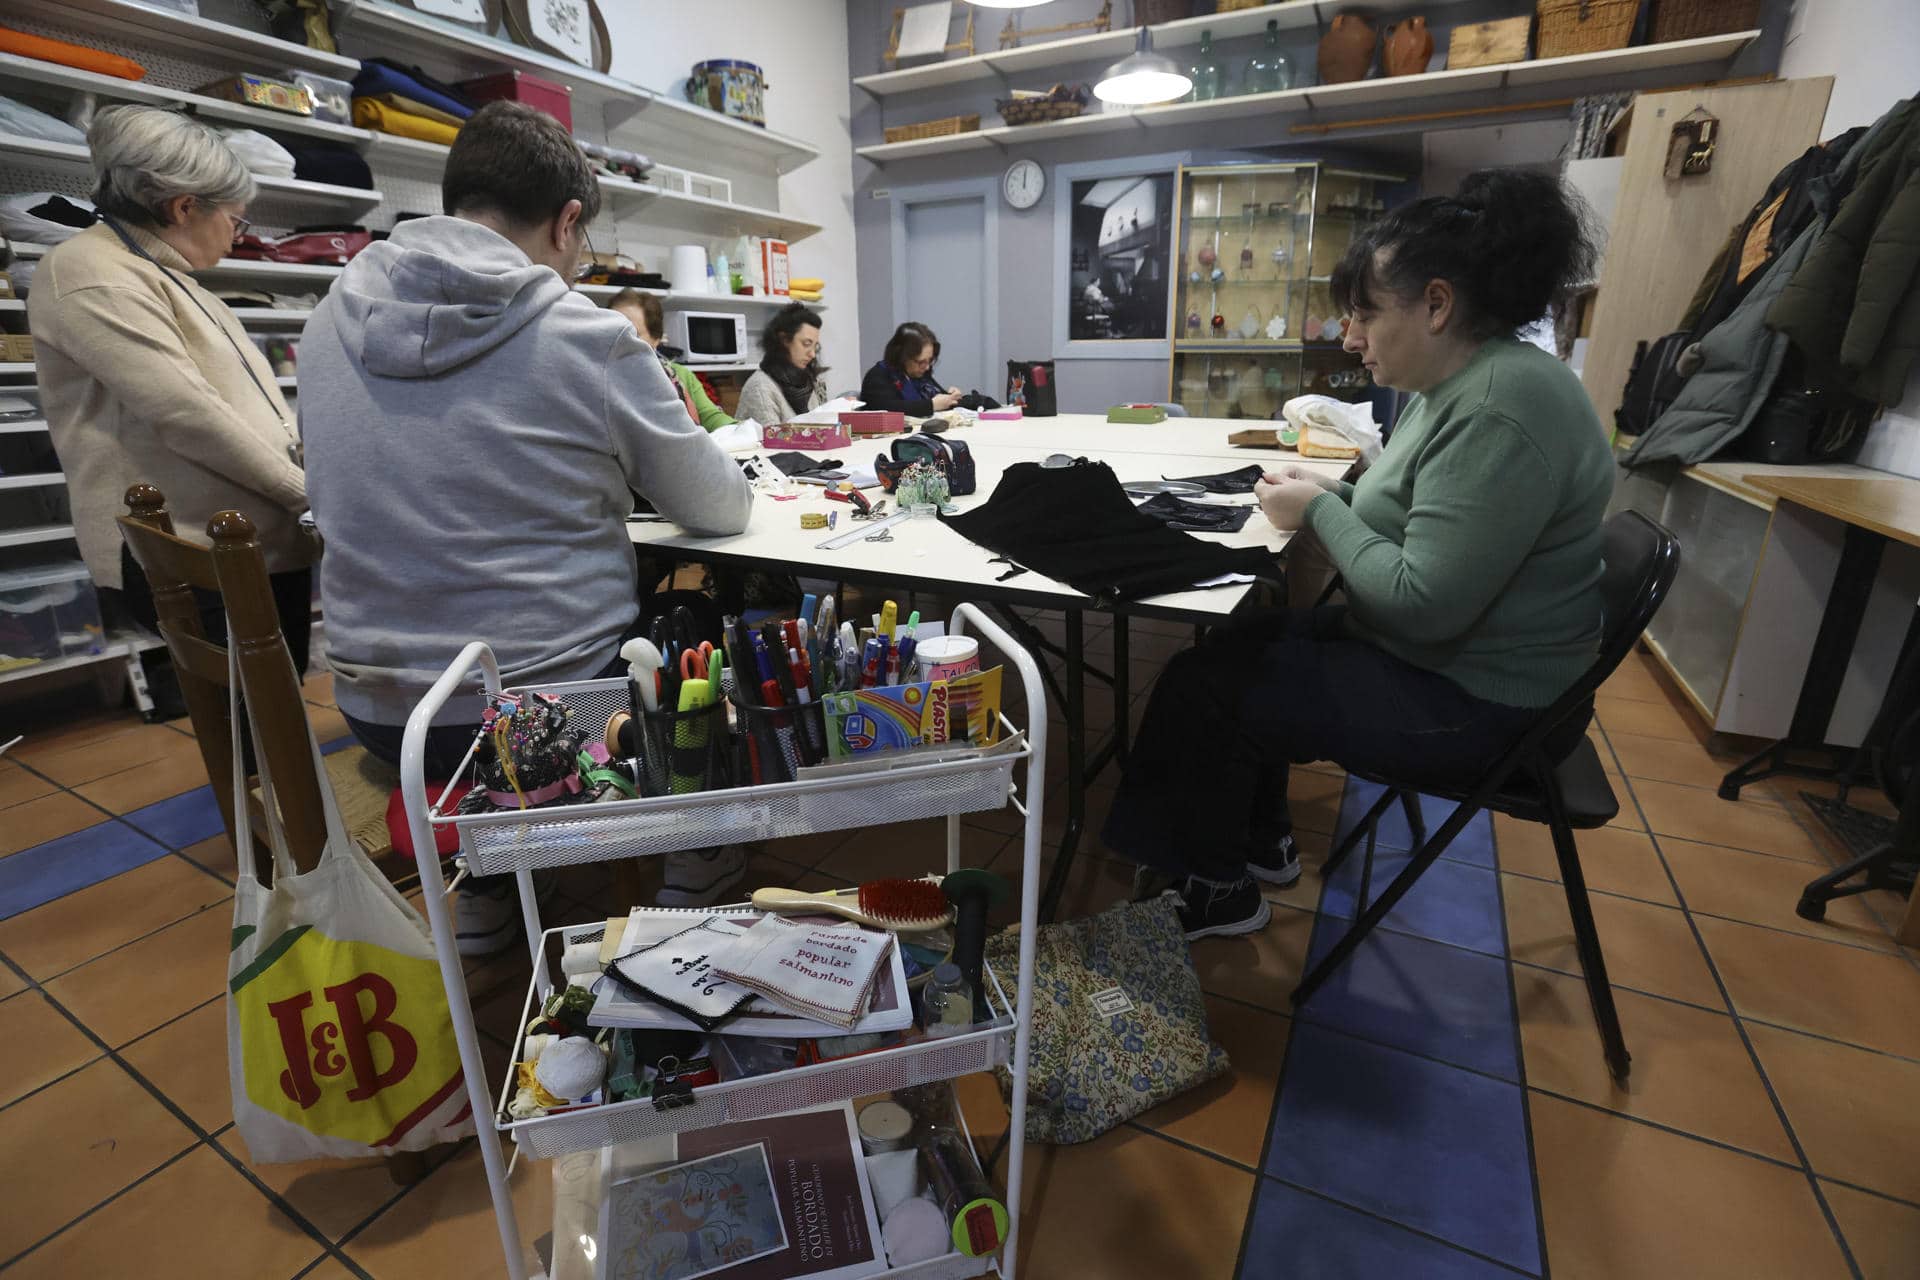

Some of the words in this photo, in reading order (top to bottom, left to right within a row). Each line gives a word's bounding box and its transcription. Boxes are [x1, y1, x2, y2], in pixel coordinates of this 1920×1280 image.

[796, 948, 852, 969] popular
[805, 938, 858, 954] bordado
[267, 972, 418, 1110] J&B
[788, 1159, 800, 1198] POPULAR
[793, 1199, 809, 1262] SALMANTINO
[801, 1181, 824, 1259] BORDADO
